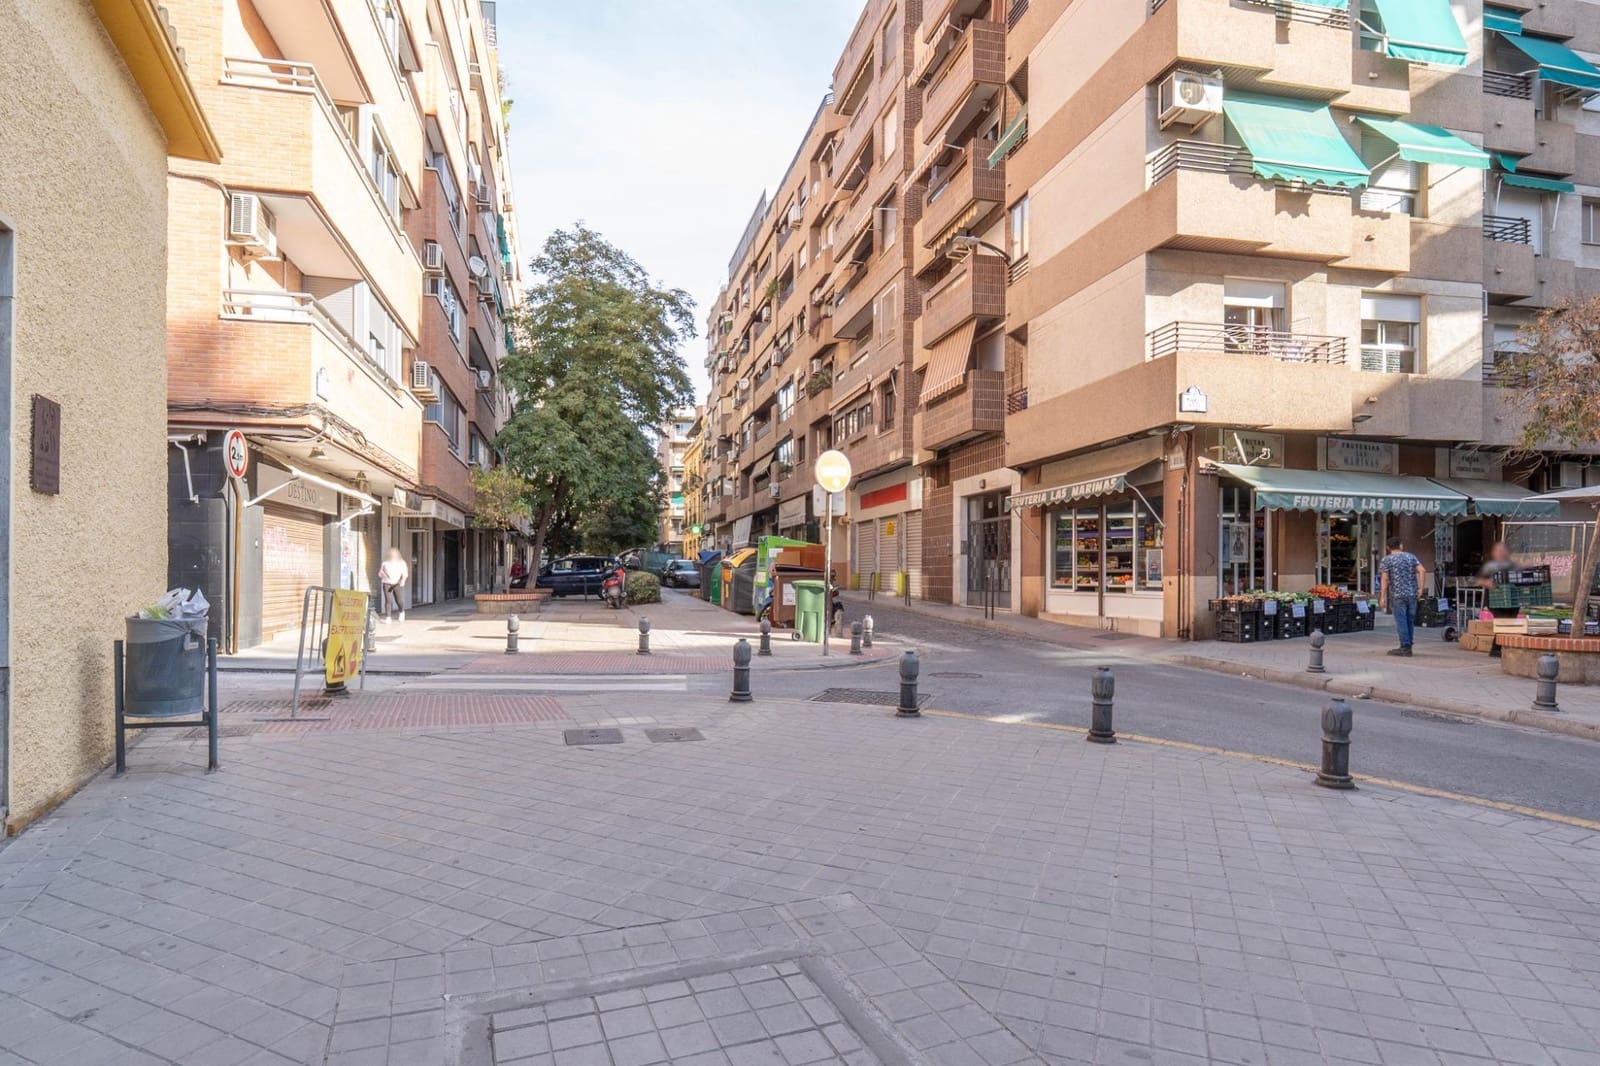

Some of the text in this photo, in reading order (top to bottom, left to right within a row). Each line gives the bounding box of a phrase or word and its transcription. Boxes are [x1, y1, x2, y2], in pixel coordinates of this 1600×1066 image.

[287, 482, 318, 505] DESTINO
[1050, 487, 1067, 501] LAS
[1071, 477, 1118, 495] MARINAS
[1293, 495, 1441, 511] FRUTERIA LAS MARINAS
